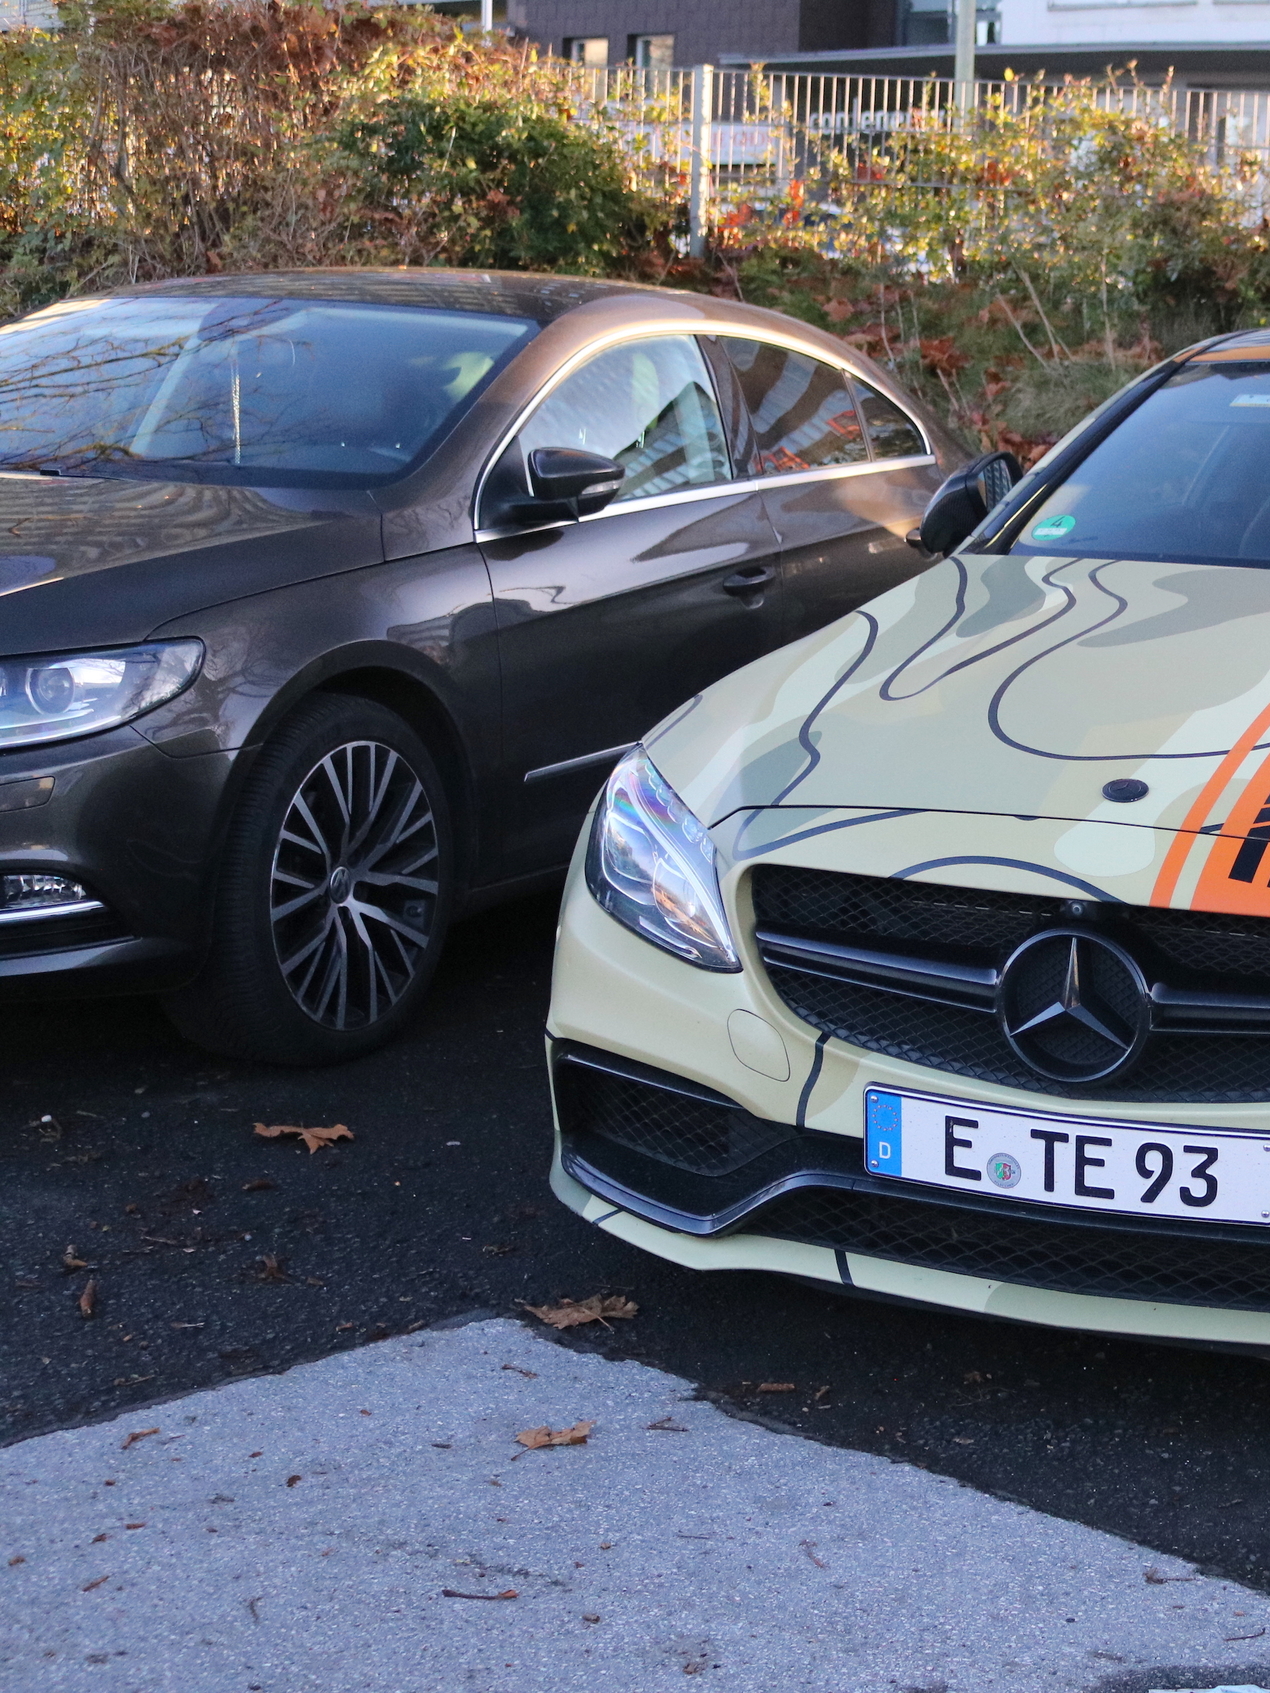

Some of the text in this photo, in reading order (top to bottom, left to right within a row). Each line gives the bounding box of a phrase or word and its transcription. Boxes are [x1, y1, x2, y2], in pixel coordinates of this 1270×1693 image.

[878, 1140, 892, 1160] D
[944, 1114, 982, 1182] E
[1029, 1128, 1115, 1200] TE
[1134, 1142, 1219, 1208] 93
